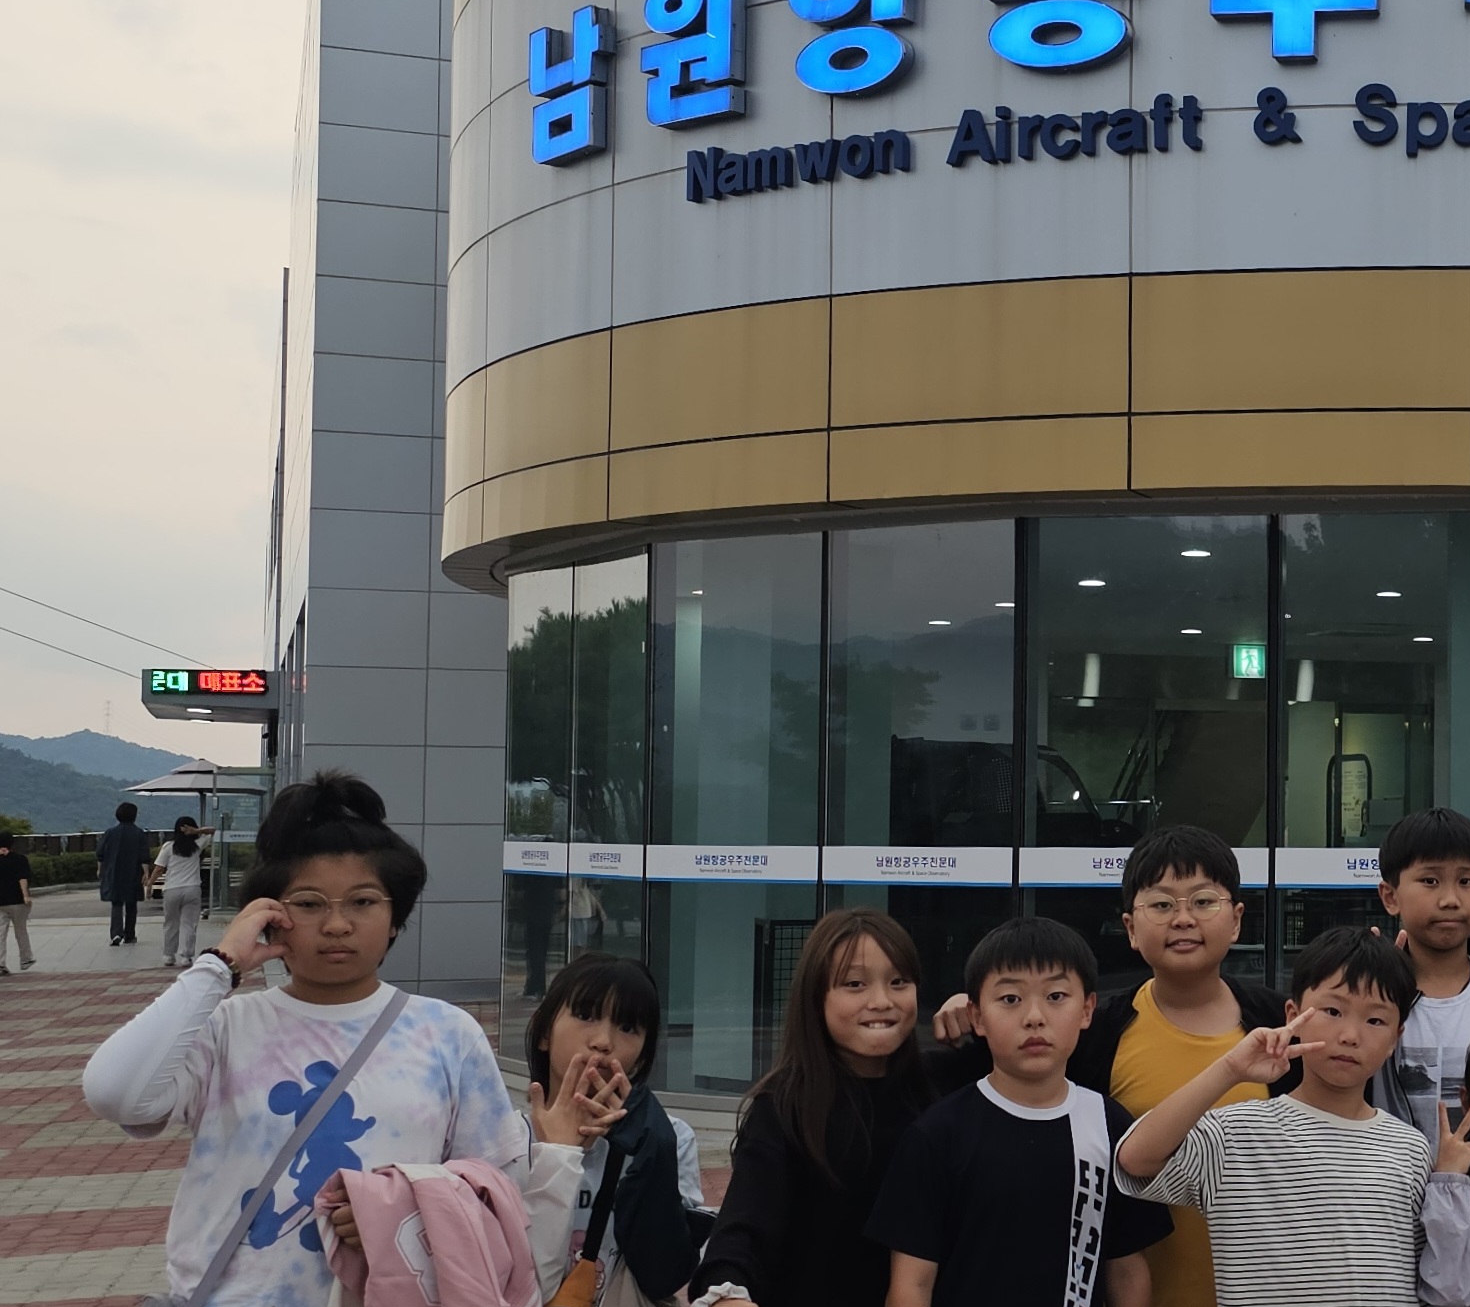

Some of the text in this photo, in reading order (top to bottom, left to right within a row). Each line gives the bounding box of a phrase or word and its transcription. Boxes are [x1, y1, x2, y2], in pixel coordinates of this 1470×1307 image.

[685, 128, 911, 203] Namwon
[946, 93, 1202, 167] Aircraft
[1252, 87, 1301, 144] &
